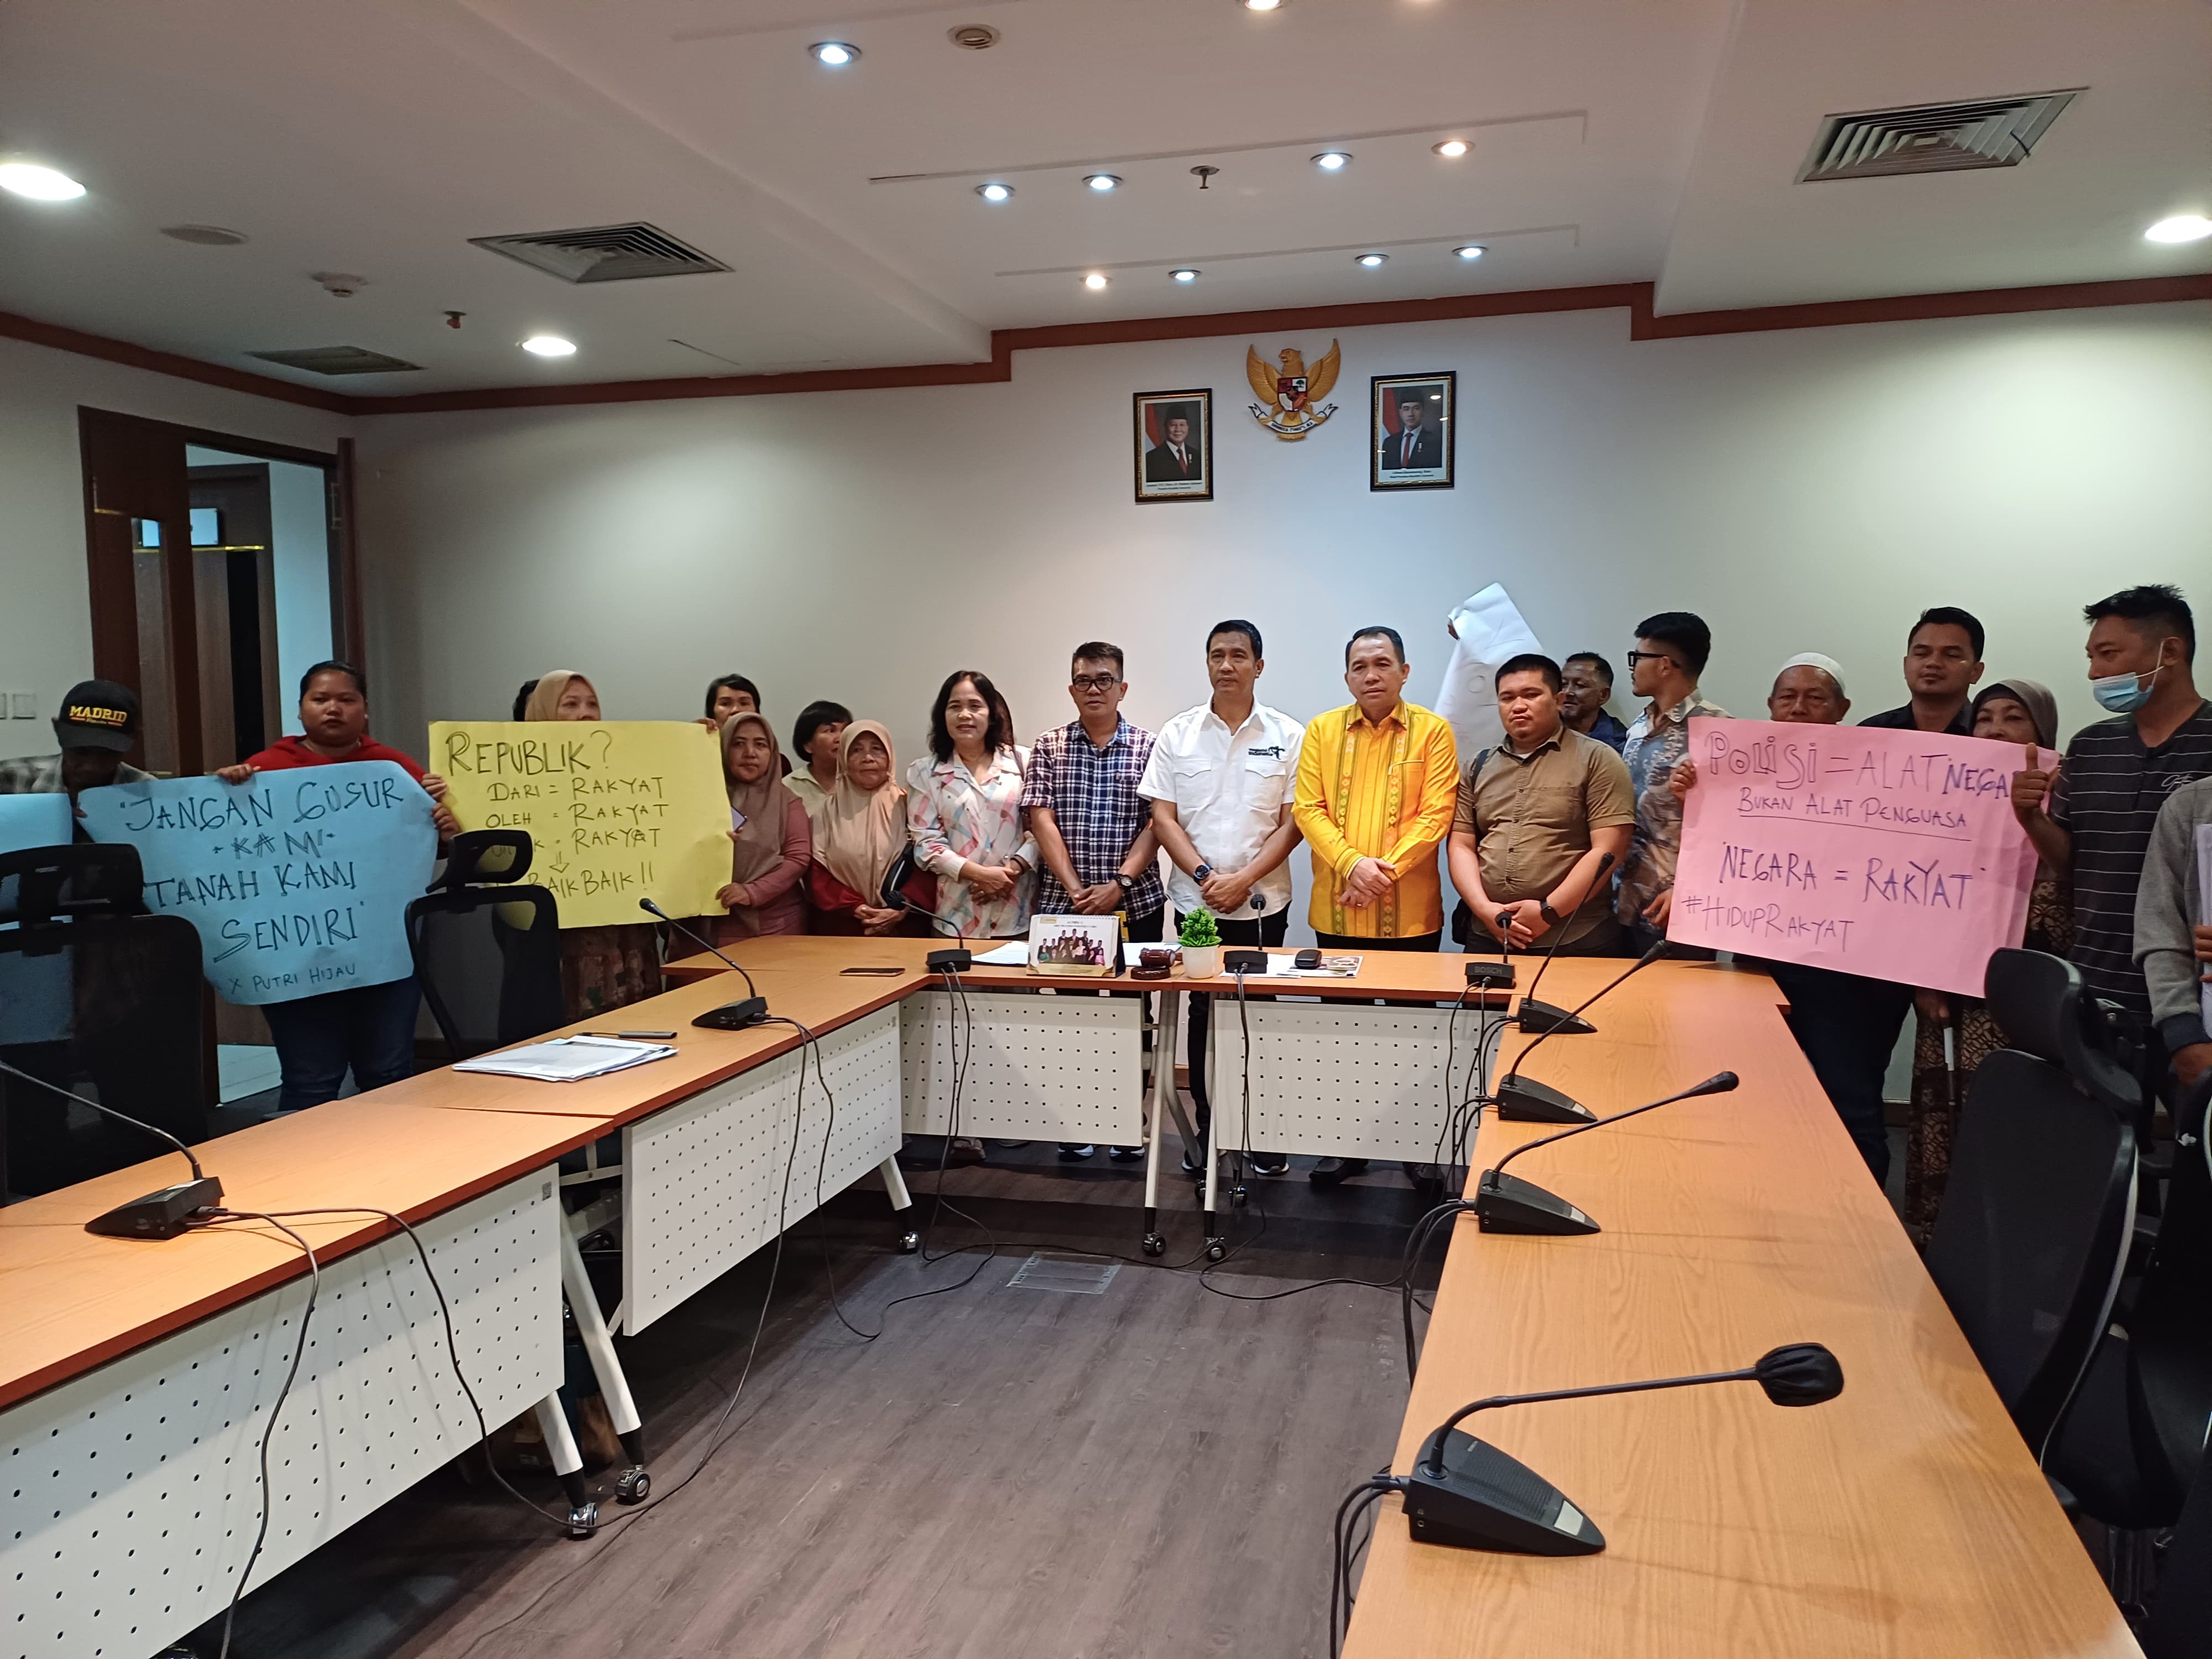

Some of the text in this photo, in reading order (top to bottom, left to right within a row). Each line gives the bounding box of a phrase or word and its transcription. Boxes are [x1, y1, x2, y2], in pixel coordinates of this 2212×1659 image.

[69, 706, 127, 722] MADRID
[487, 782, 540, 801] DARI
[571, 776, 664, 800] RAKYAT
[1855, 750, 1948, 792] ALAT
[1942, 763, 2020, 799] NEGA
[293, 778, 404, 823] GUSUR
[1737, 786, 1966, 828] BUKAN ALAT PENGUASA
[486, 812, 532, 828] OLEH
[567, 803, 669, 827] RAKYAT
[571, 828, 661, 855] RAKYAT
[143, 860, 357, 907] TANAH KAMI
[1718, 844, 1818, 891] NEGARA
[1863, 857, 1974, 910] RAKYAT
[252, 973, 299, 992] PUTRI
[309, 963, 356, 985] HIJAU
[1474, 966, 1503, 974] BOSCH
